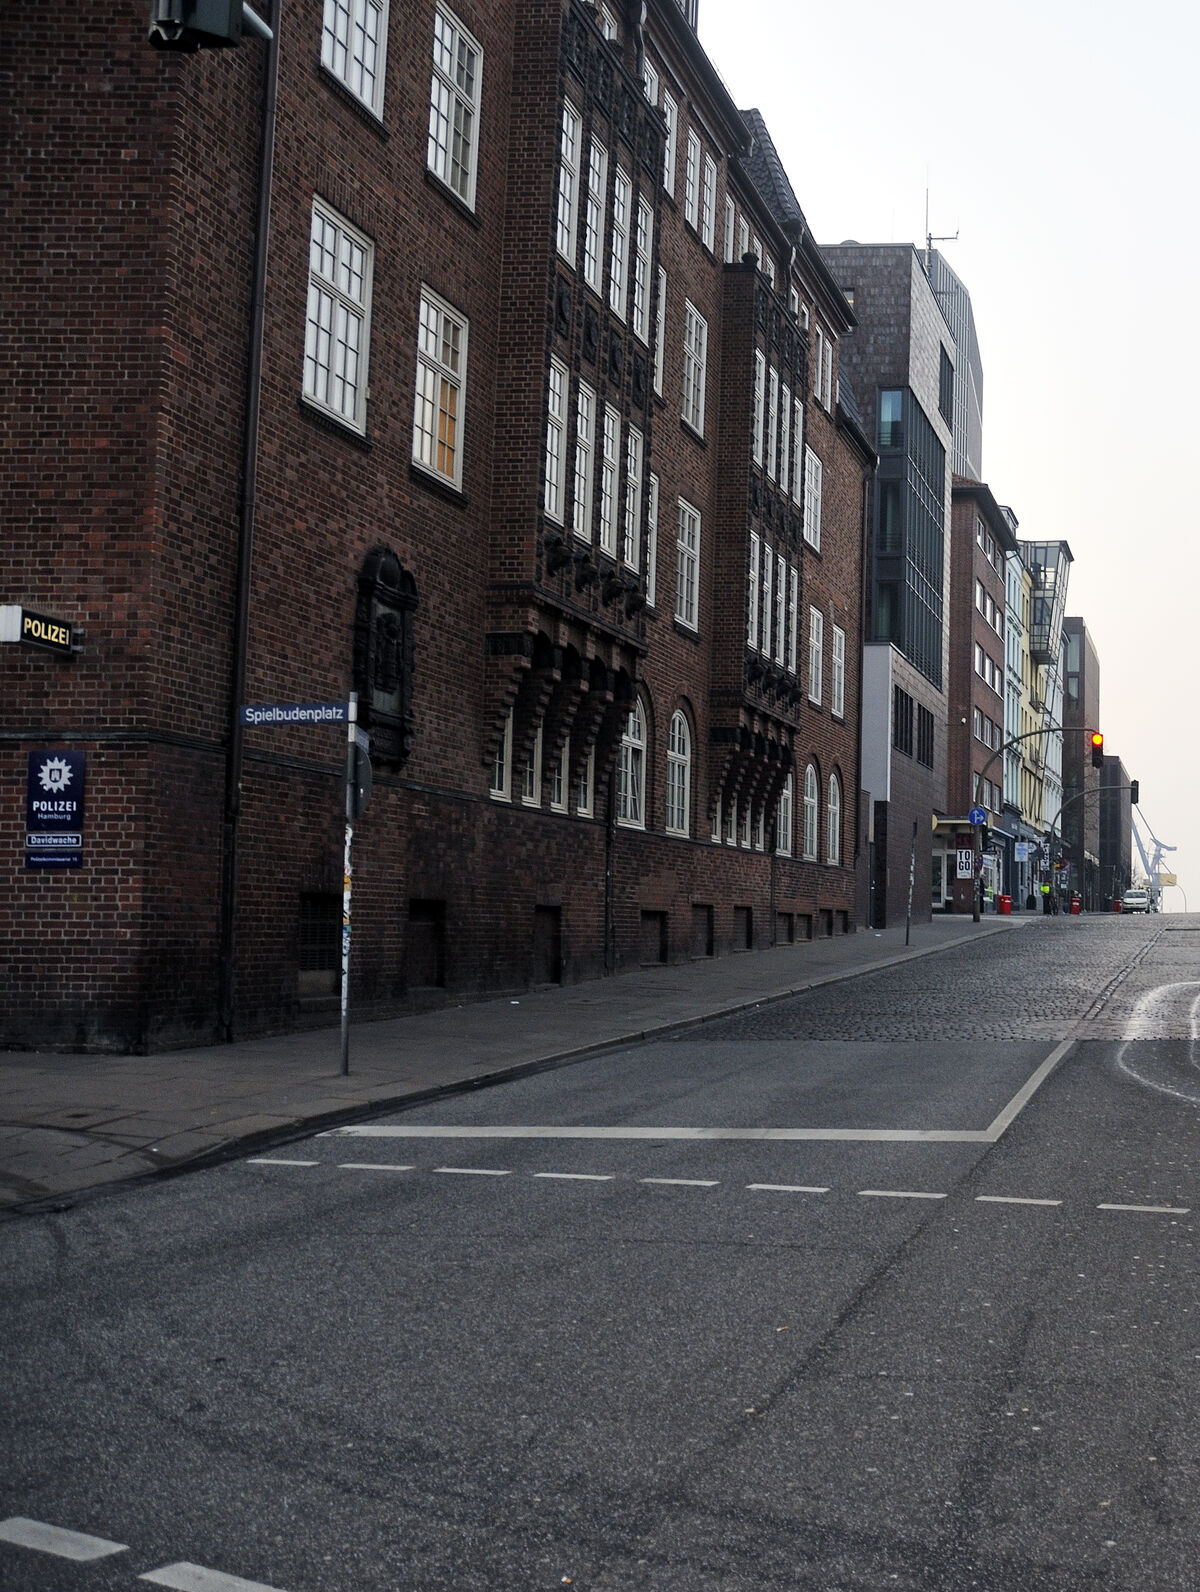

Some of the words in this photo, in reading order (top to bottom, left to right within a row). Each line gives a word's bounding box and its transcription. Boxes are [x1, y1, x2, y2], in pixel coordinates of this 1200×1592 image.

[24, 617, 69, 645] POLIZEI
[245, 706, 343, 725] Spielbudenplatz
[33, 801, 76, 811] POLIZEI
[38, 813, 71, 821] Hamburg
[31, 836, 77, 844] Davidwache
[958, 850, 970, 860] TO
[958, 861, 970, 871] GO
